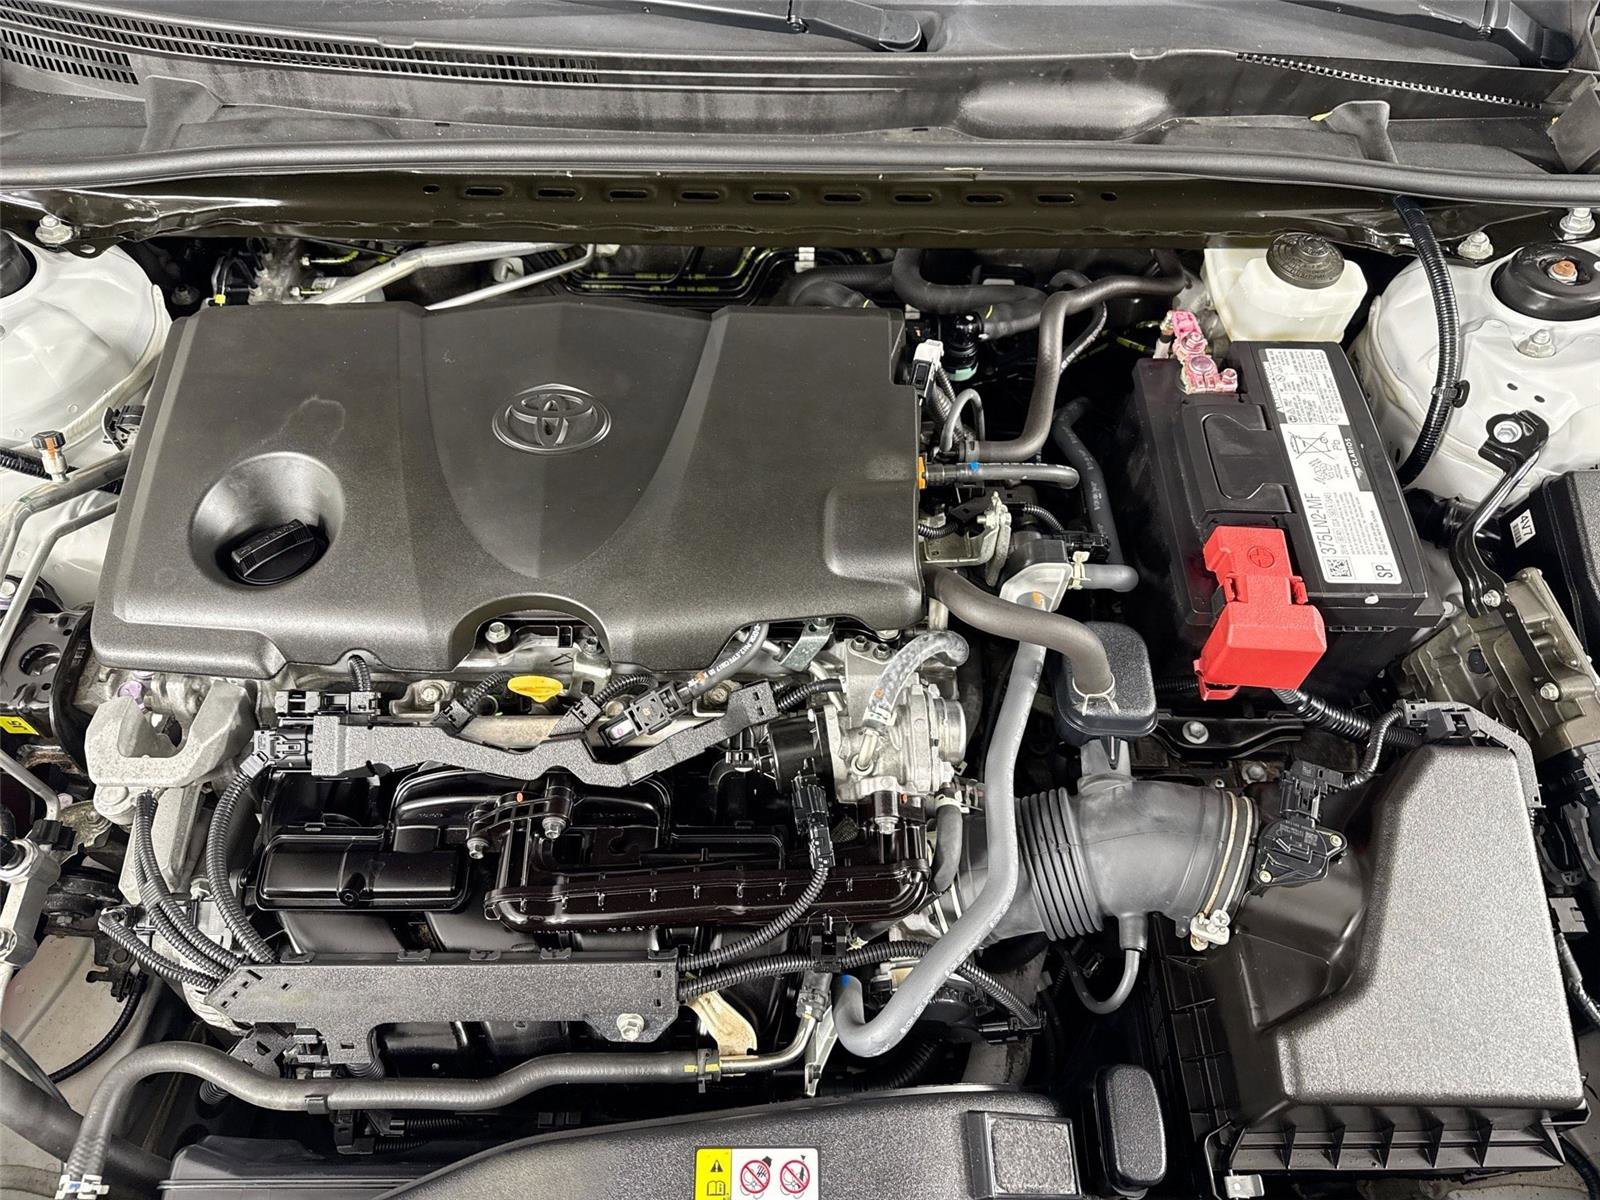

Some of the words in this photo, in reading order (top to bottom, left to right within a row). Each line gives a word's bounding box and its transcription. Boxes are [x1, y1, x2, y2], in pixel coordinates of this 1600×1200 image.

[1345, 438, 1359, 467] CLARIOS
[1304, 493, 1337, 555] 375LN2-MF
[1375, 564, 1394, 578] SP
